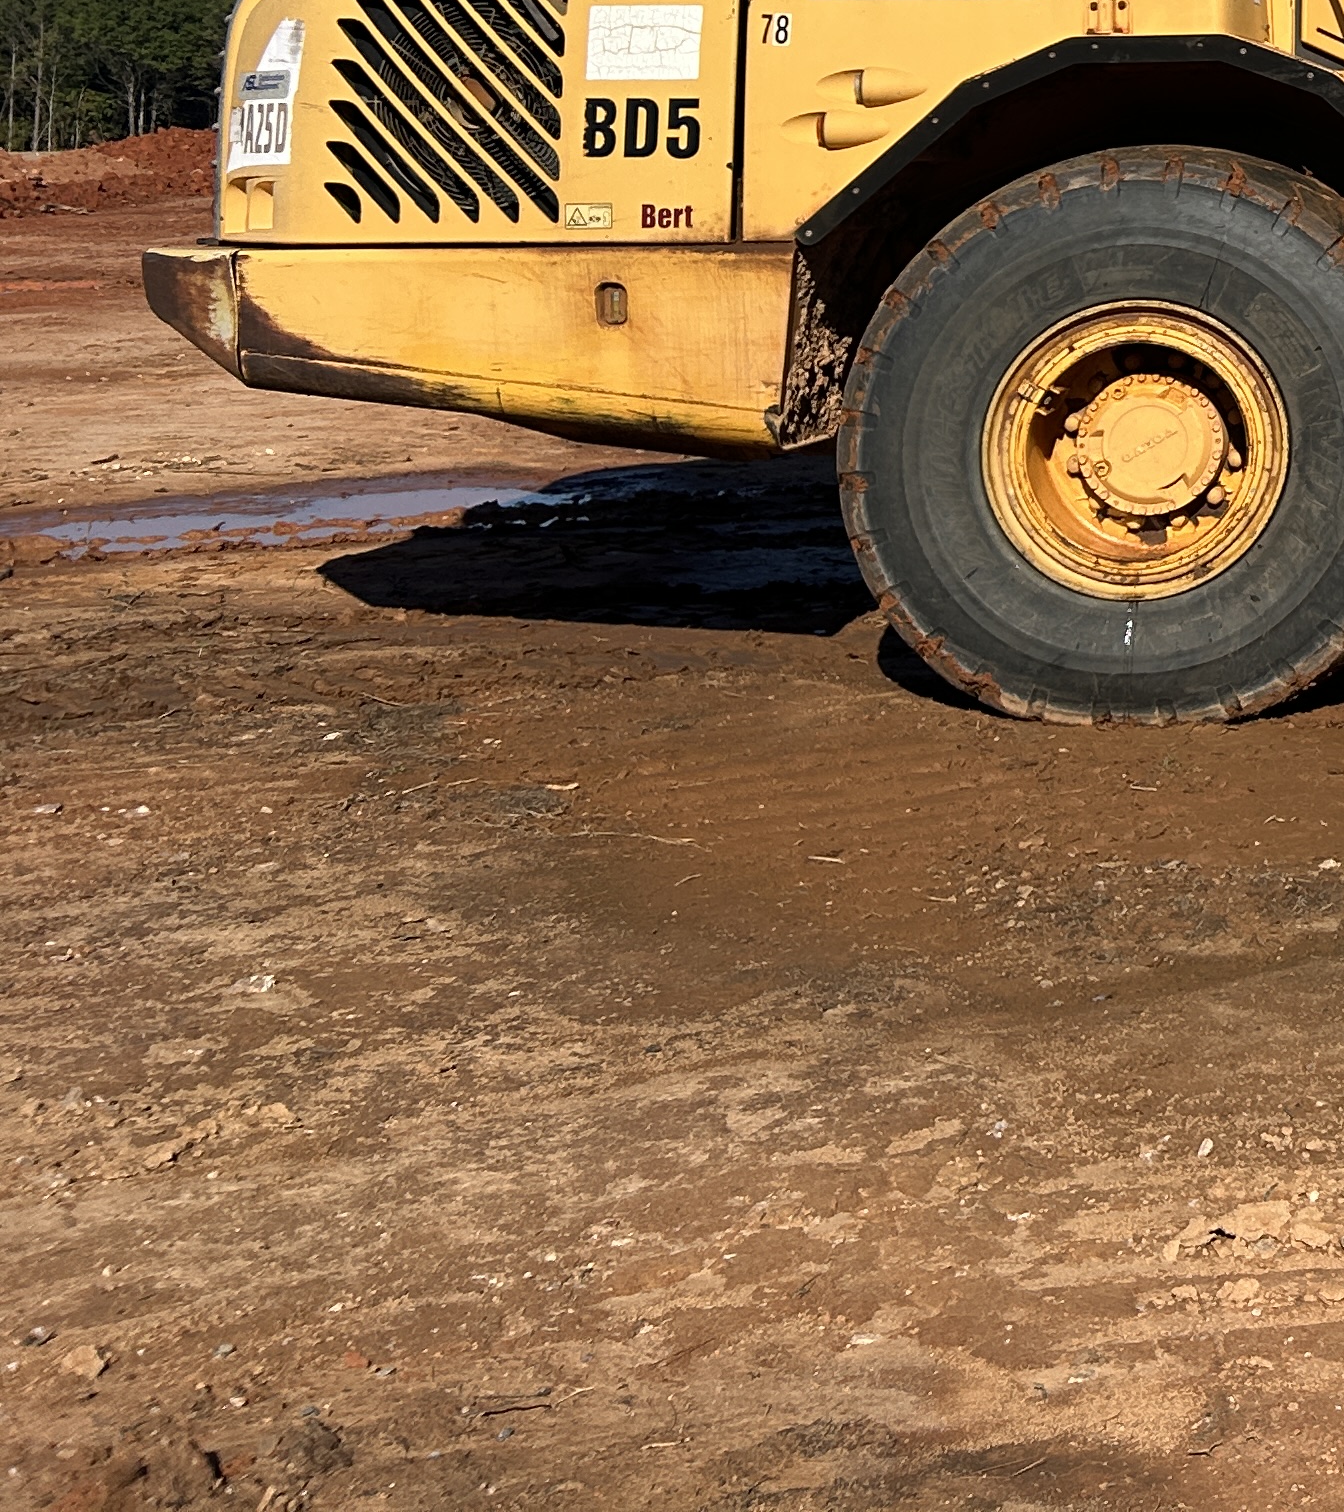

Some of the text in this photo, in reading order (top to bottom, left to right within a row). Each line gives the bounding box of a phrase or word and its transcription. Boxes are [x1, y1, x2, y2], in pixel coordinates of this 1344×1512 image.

[761, 13, 789, 44] 78
[243, 102, 289, 154] A25D
[583, 98, 701, 159] BD5
[641, 204, 693, 229] Bert
